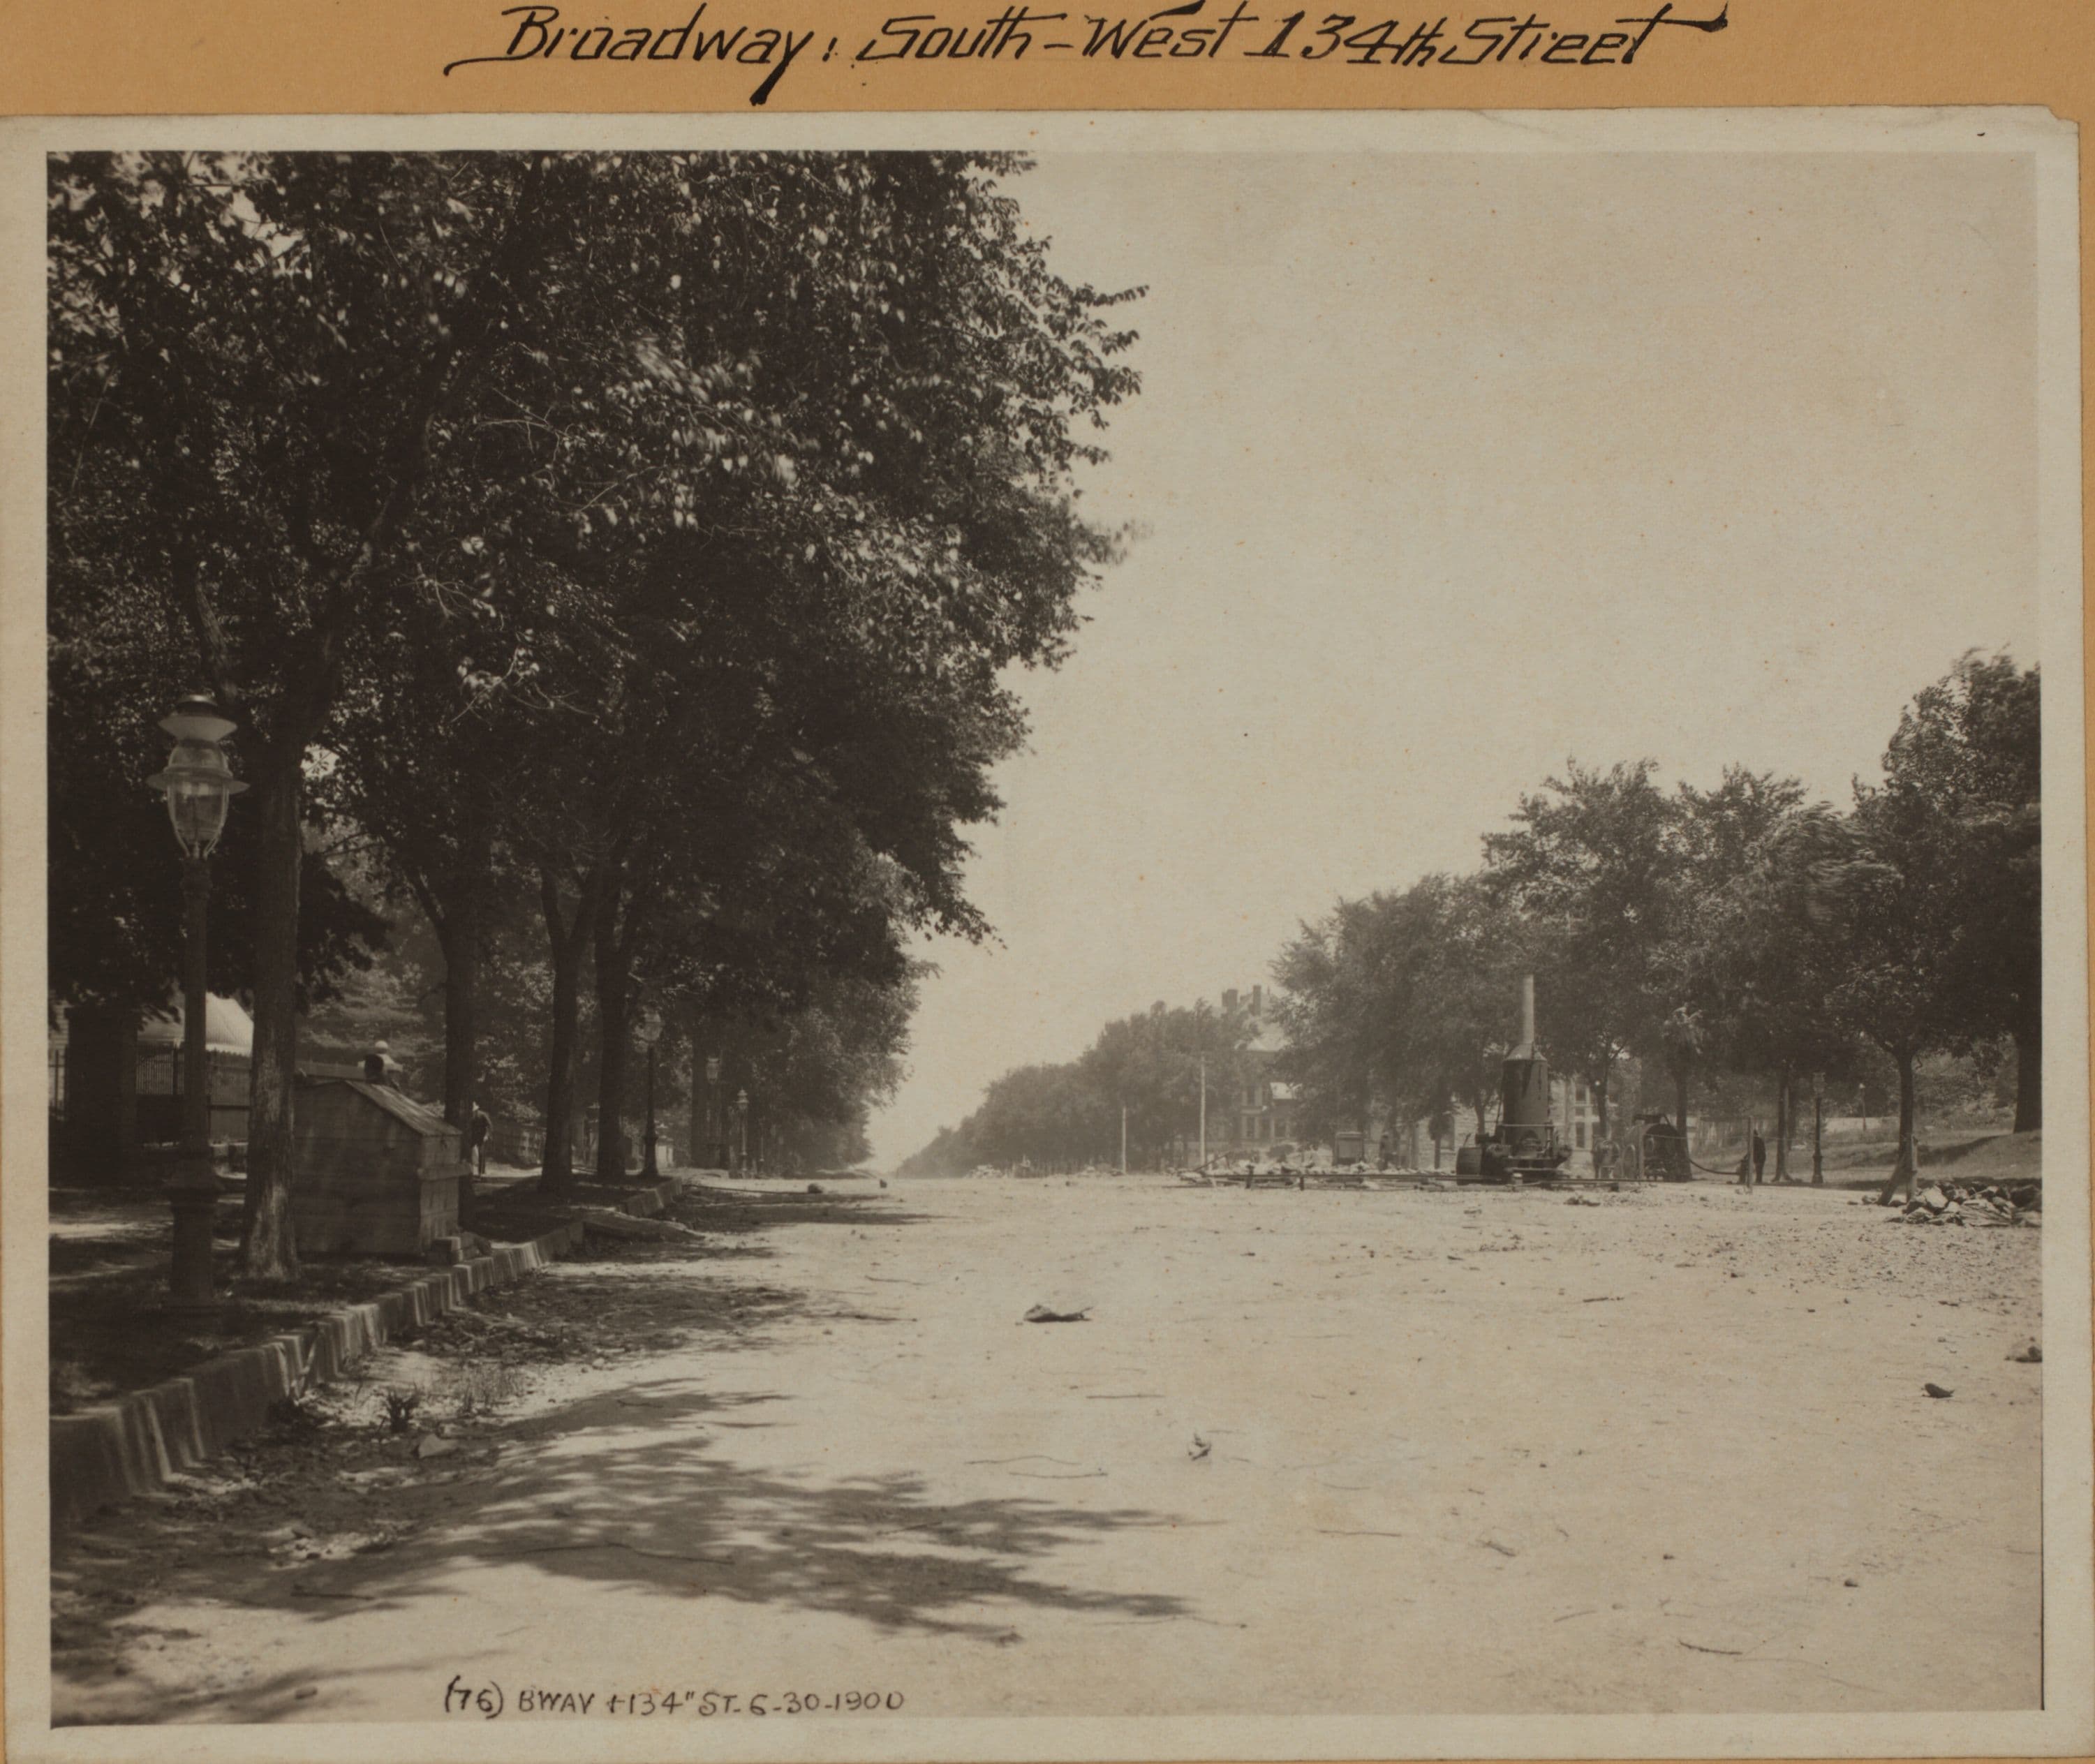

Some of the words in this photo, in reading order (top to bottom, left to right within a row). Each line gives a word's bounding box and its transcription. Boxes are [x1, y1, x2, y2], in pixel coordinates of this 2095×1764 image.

[855, 0, 1259, 61] South-West
[1243, 10, 1447, 68] 134th
[1438, 3, 1728, 66] Street
